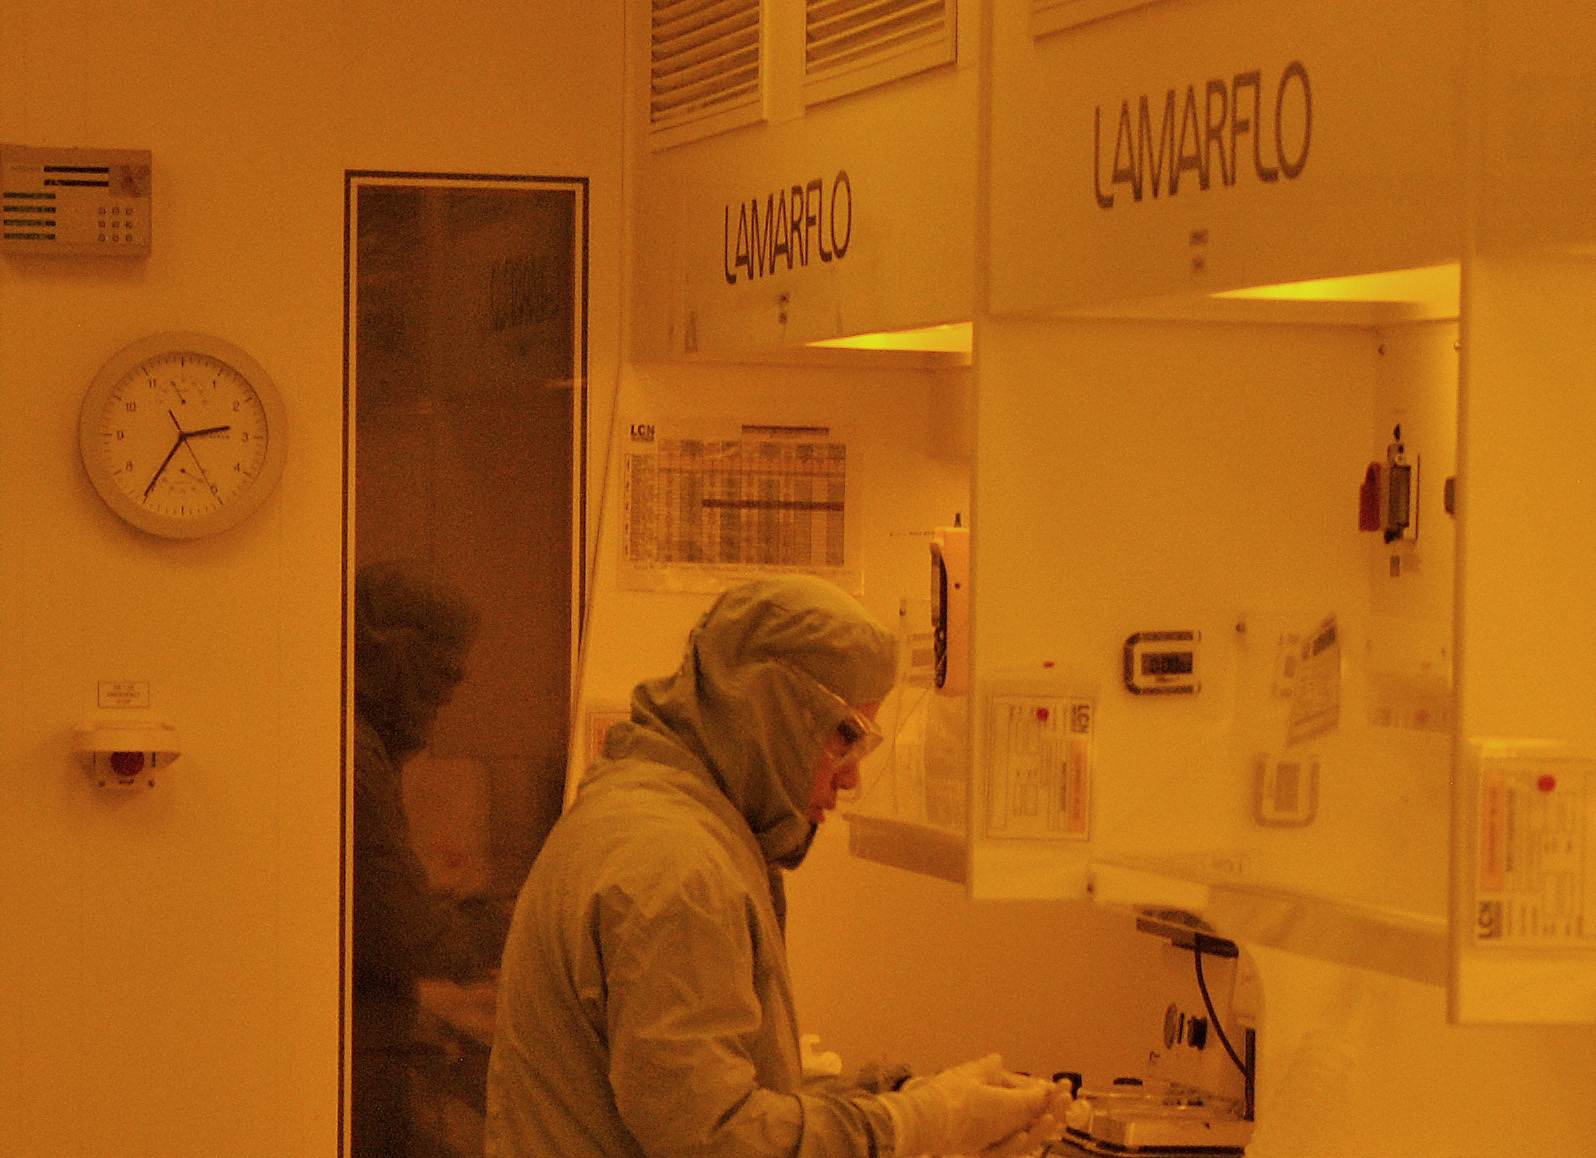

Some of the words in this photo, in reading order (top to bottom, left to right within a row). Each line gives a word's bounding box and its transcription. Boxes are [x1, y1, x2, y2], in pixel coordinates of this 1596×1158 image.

[1095, 60, 1312, 209] LAMARFLO
[724, 169, 852, 284] LAMARFLO
[631, 424, 655, 436] LCN
